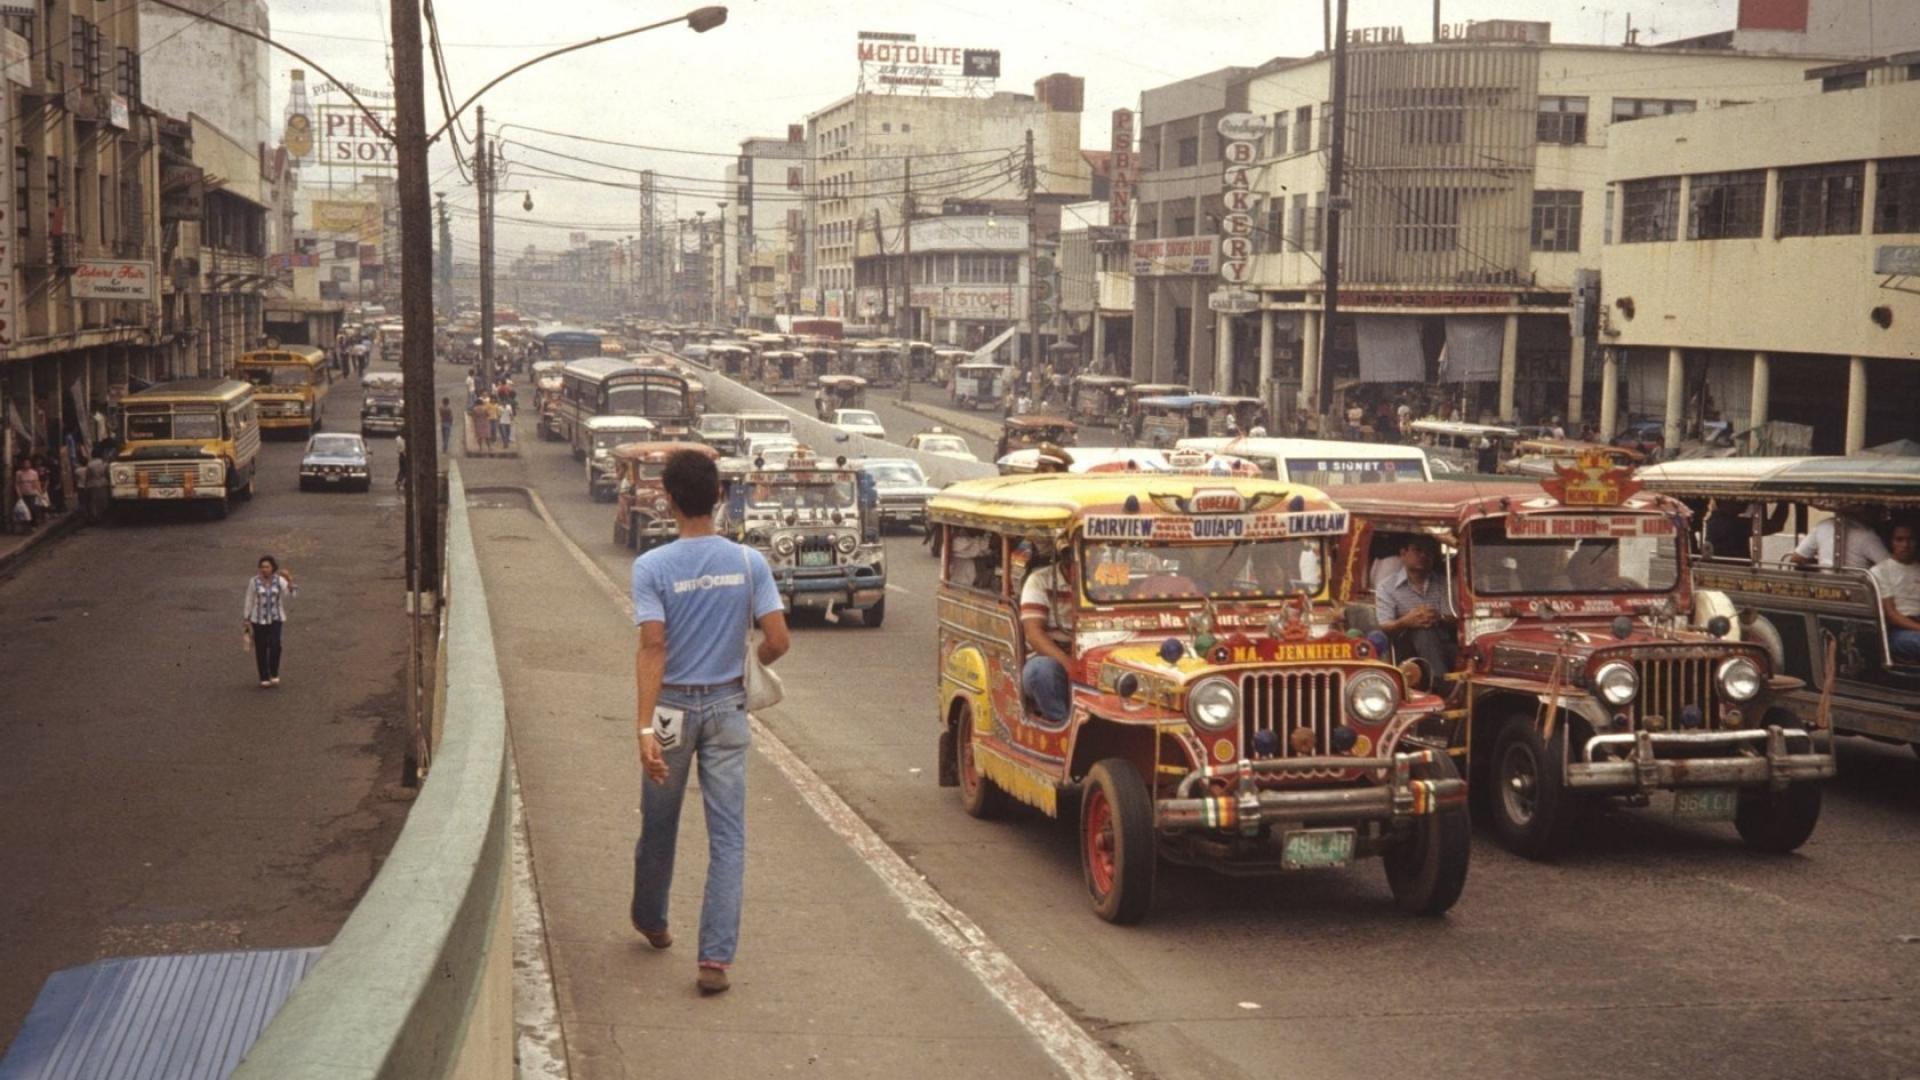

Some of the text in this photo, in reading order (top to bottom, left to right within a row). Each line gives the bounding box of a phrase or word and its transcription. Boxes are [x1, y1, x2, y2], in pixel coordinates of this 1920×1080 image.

[858, 43, 961, 66] MOTOLITE
[337, 141, 395, 161] SOY
[1113, 113, 1132, 225] PSBANK
[1230, 143, 1250, 281] BAKERY
[1087, 517, 1153, 537] FAIRVIEW
[1193, 518, 1244, 537] QUIAPO
[1274, 642, 1351, 661] JENNIFER
